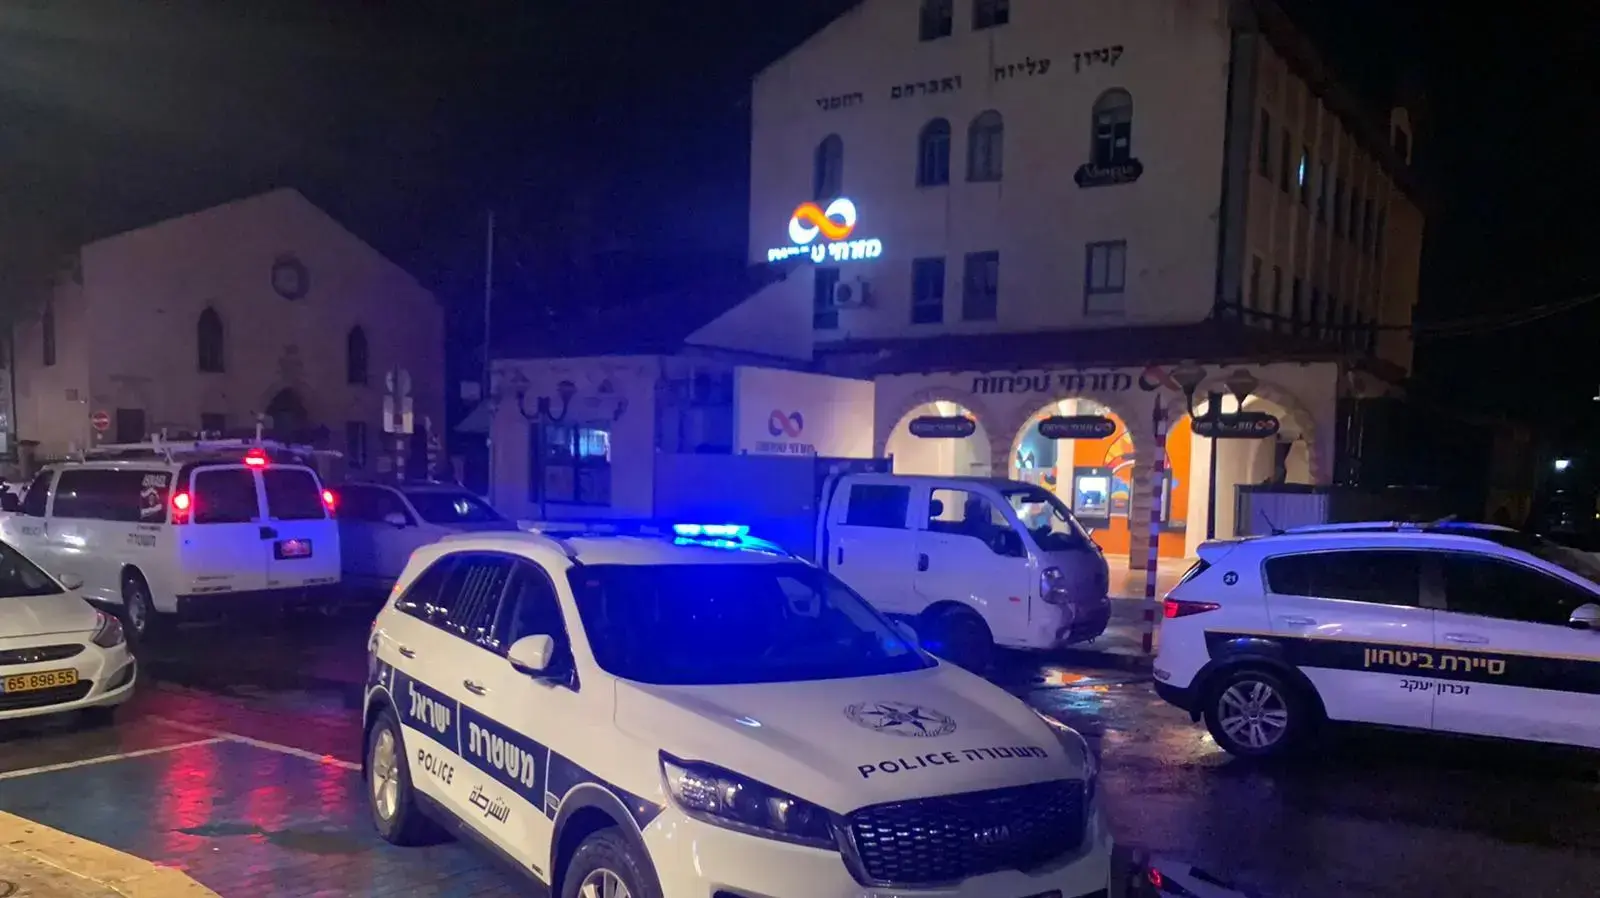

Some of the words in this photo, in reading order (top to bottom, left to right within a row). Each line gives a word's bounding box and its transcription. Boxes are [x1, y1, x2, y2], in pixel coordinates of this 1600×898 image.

[1073, 45, 1124, 73] קניון
[891, 74, 962, 100] ואברהם
[816, 92, 864, 111] רחמני
[828, 239, 882, 262] מזרחי
[971, 372, 1049, 395] טפחות
[1058, 371, 1133, 392] מזרחי
[1363, 648, 1435, 668] ביטחון
[1438, 654, 1506, 675] סיירת
[1400, 679, 1433, 693] יעקב
[1437, 681, 1471, 695] זכרון
[409, 681, 450, 733] ישראל
[469, 721, 535, 788] משטרת
[857, 752, 960, 778] POLICE
[961, 746, 1049, 761] משטרה
[418, 748, 455, 785] POLICE
[468, 784, 511, 824] الشرطة
